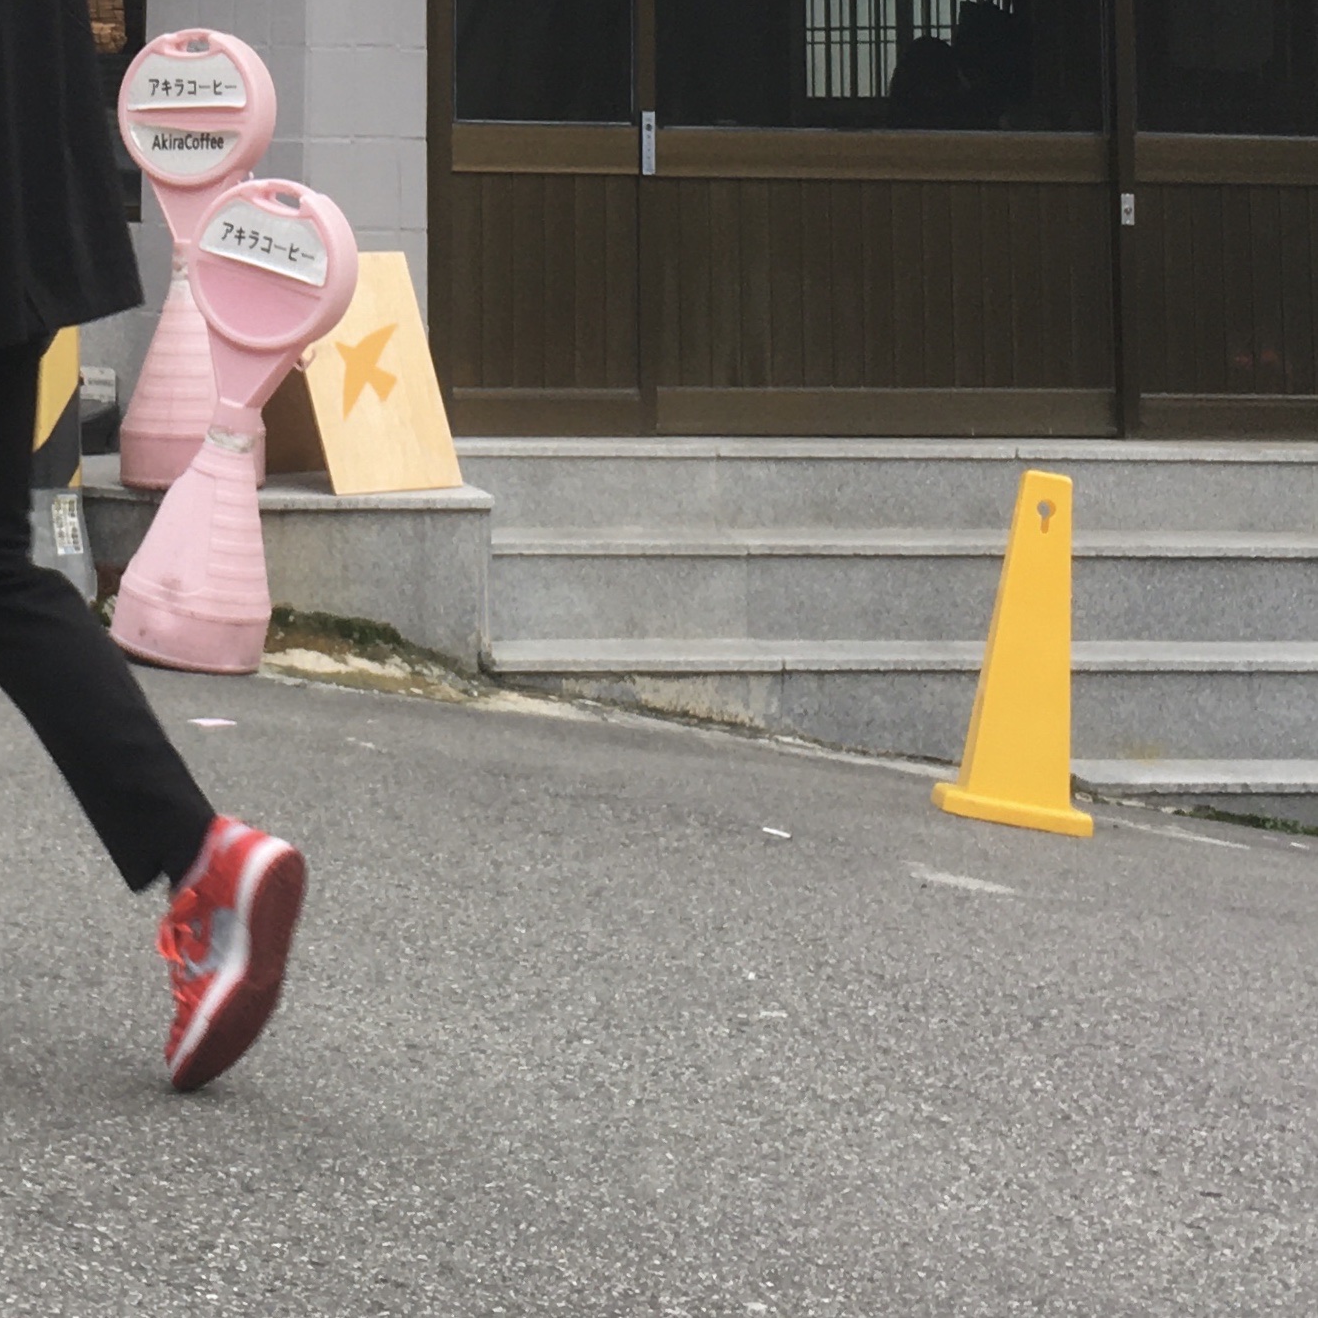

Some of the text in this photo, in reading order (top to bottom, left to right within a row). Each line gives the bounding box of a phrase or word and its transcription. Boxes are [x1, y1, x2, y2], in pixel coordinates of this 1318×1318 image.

[148, 78, 238, 97] アキラコーヒー
[152, 133, 224, 151] AkiraCoffee
[221, 222, 316, 263] アキラコーヒー
